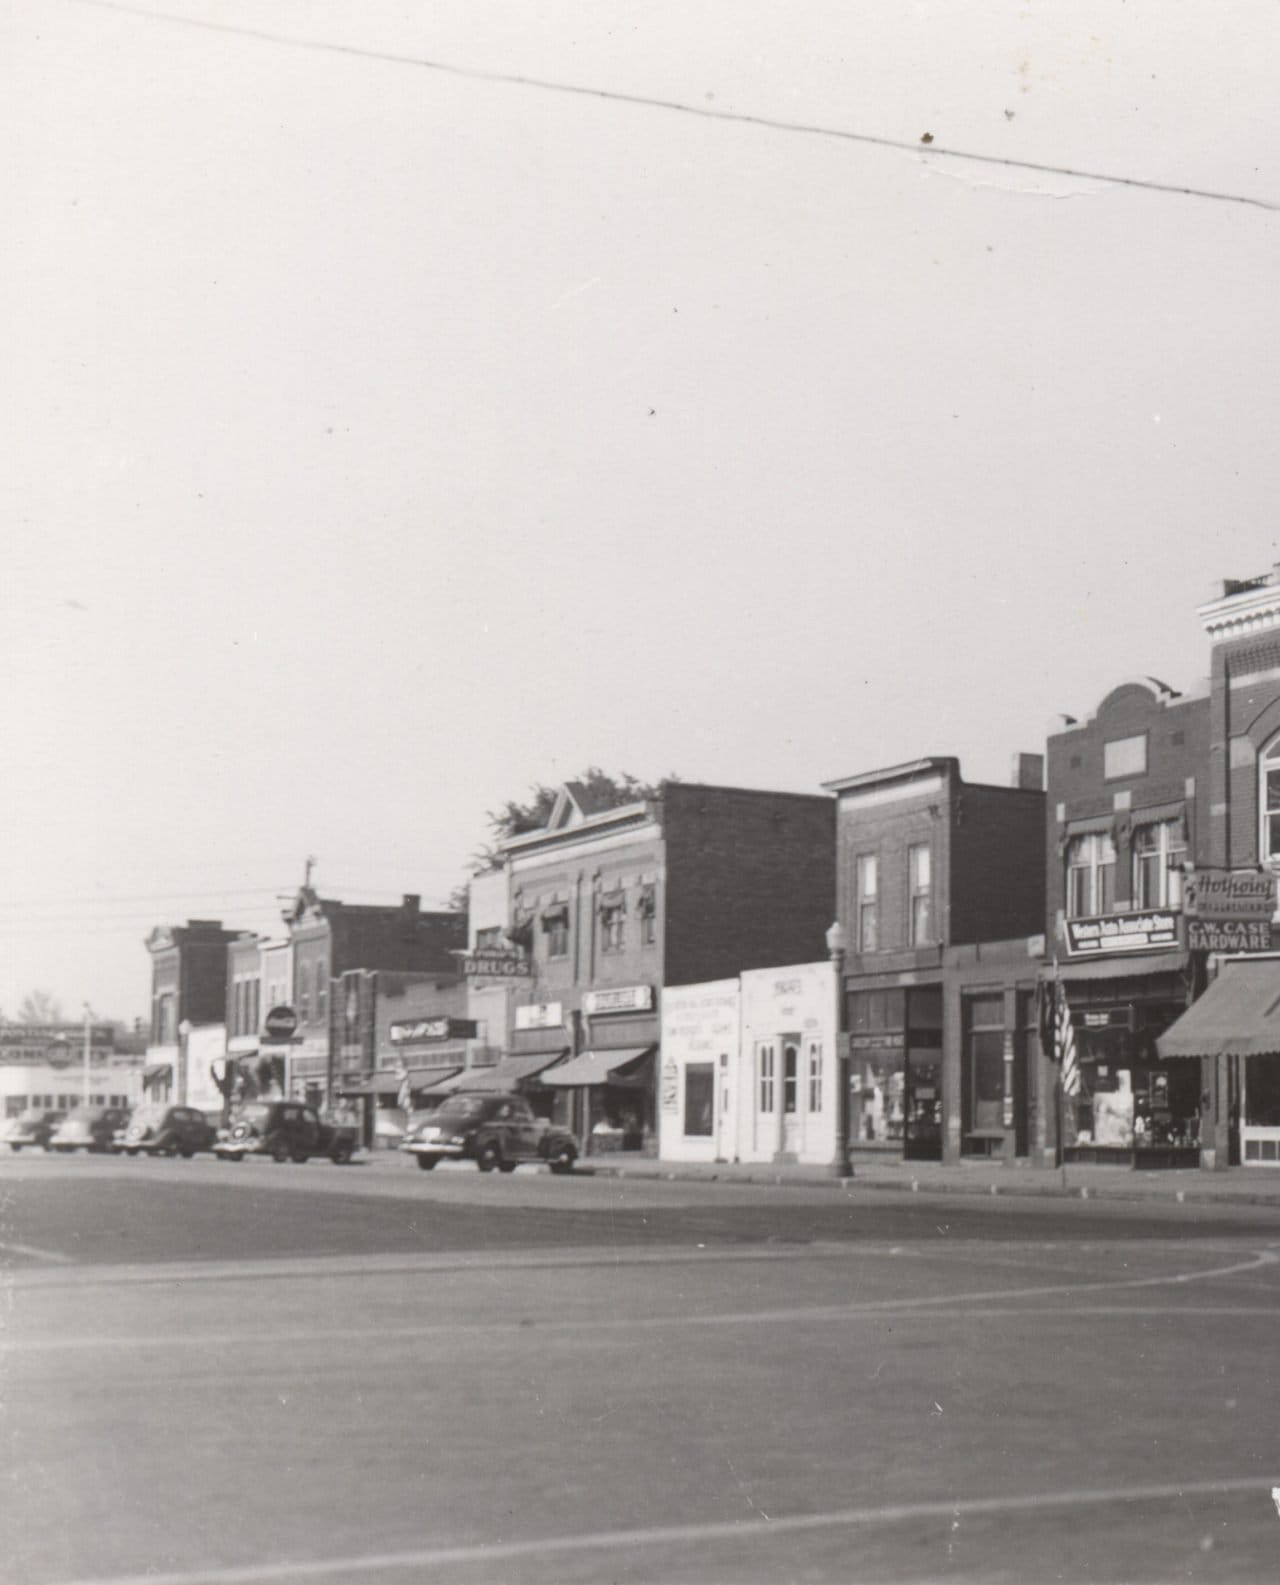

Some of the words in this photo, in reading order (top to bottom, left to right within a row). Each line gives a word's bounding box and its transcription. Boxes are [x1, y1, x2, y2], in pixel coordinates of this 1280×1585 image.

[1198, 876, 1274, 901] Hotpoint
[1188, 922, 1220, 934] C.W.
[1223, 922, 1270, 934] CASE
[1188, 935, 1270, 950] HARDWARE
[463, 959, 529, 974] DRUGS
